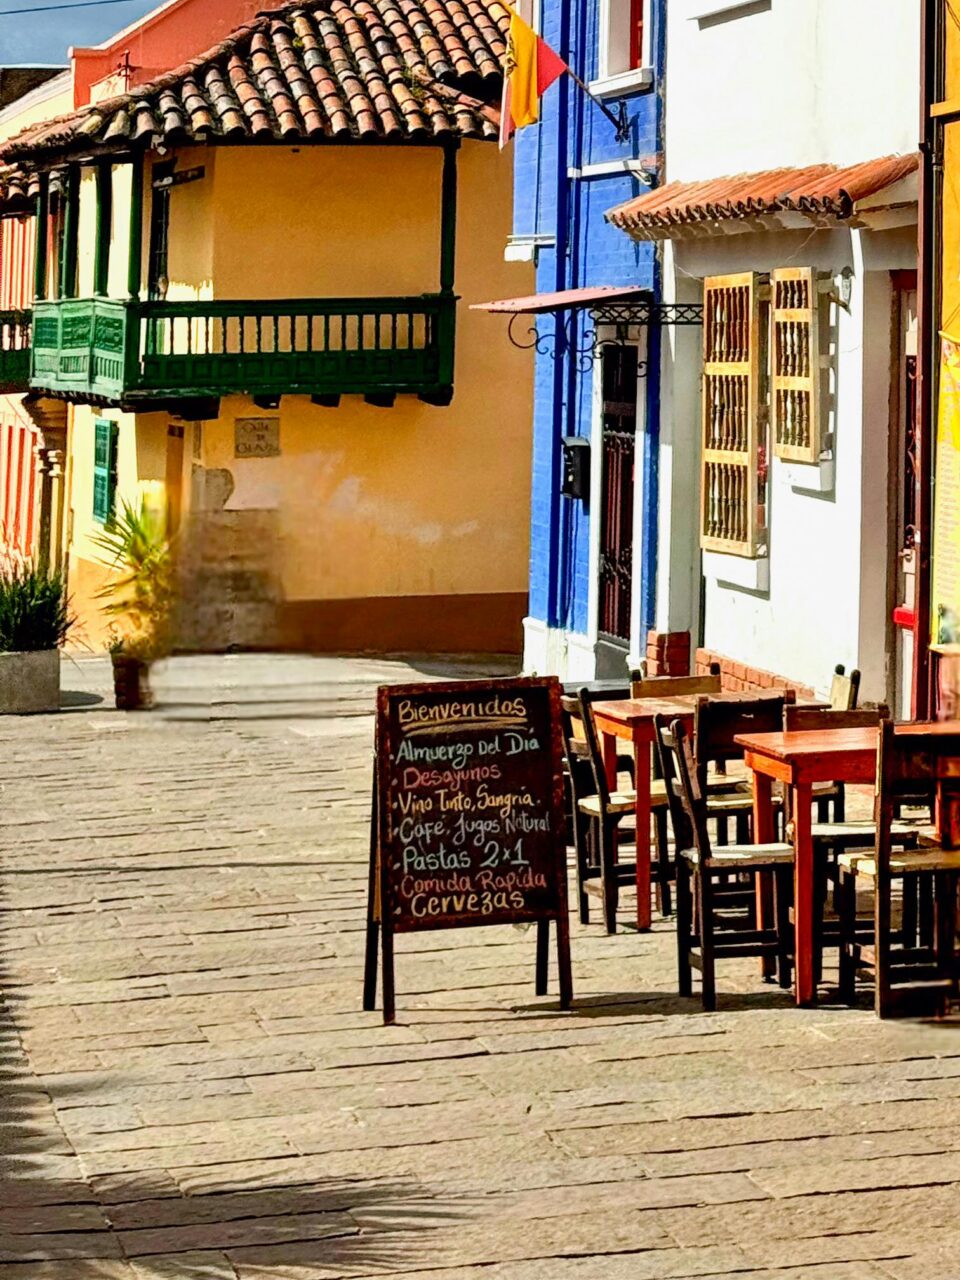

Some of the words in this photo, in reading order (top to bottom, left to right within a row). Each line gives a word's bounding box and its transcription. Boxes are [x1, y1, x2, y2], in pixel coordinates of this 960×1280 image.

[399, 695, 527, 722] Bienvenidos
[395, 739, 474, 770] Almuerzo
[478, 735, 501, 755] Del
[403, 764, 502, 791] Desayunos
[399, 792, 433, 815] Vino
[505, 809, 550, 835] Natural
[402, 842, 472, 874] Pastas
[401, 872, 476, 898] Comida
[411, 891, 525, 917] Cervezas
